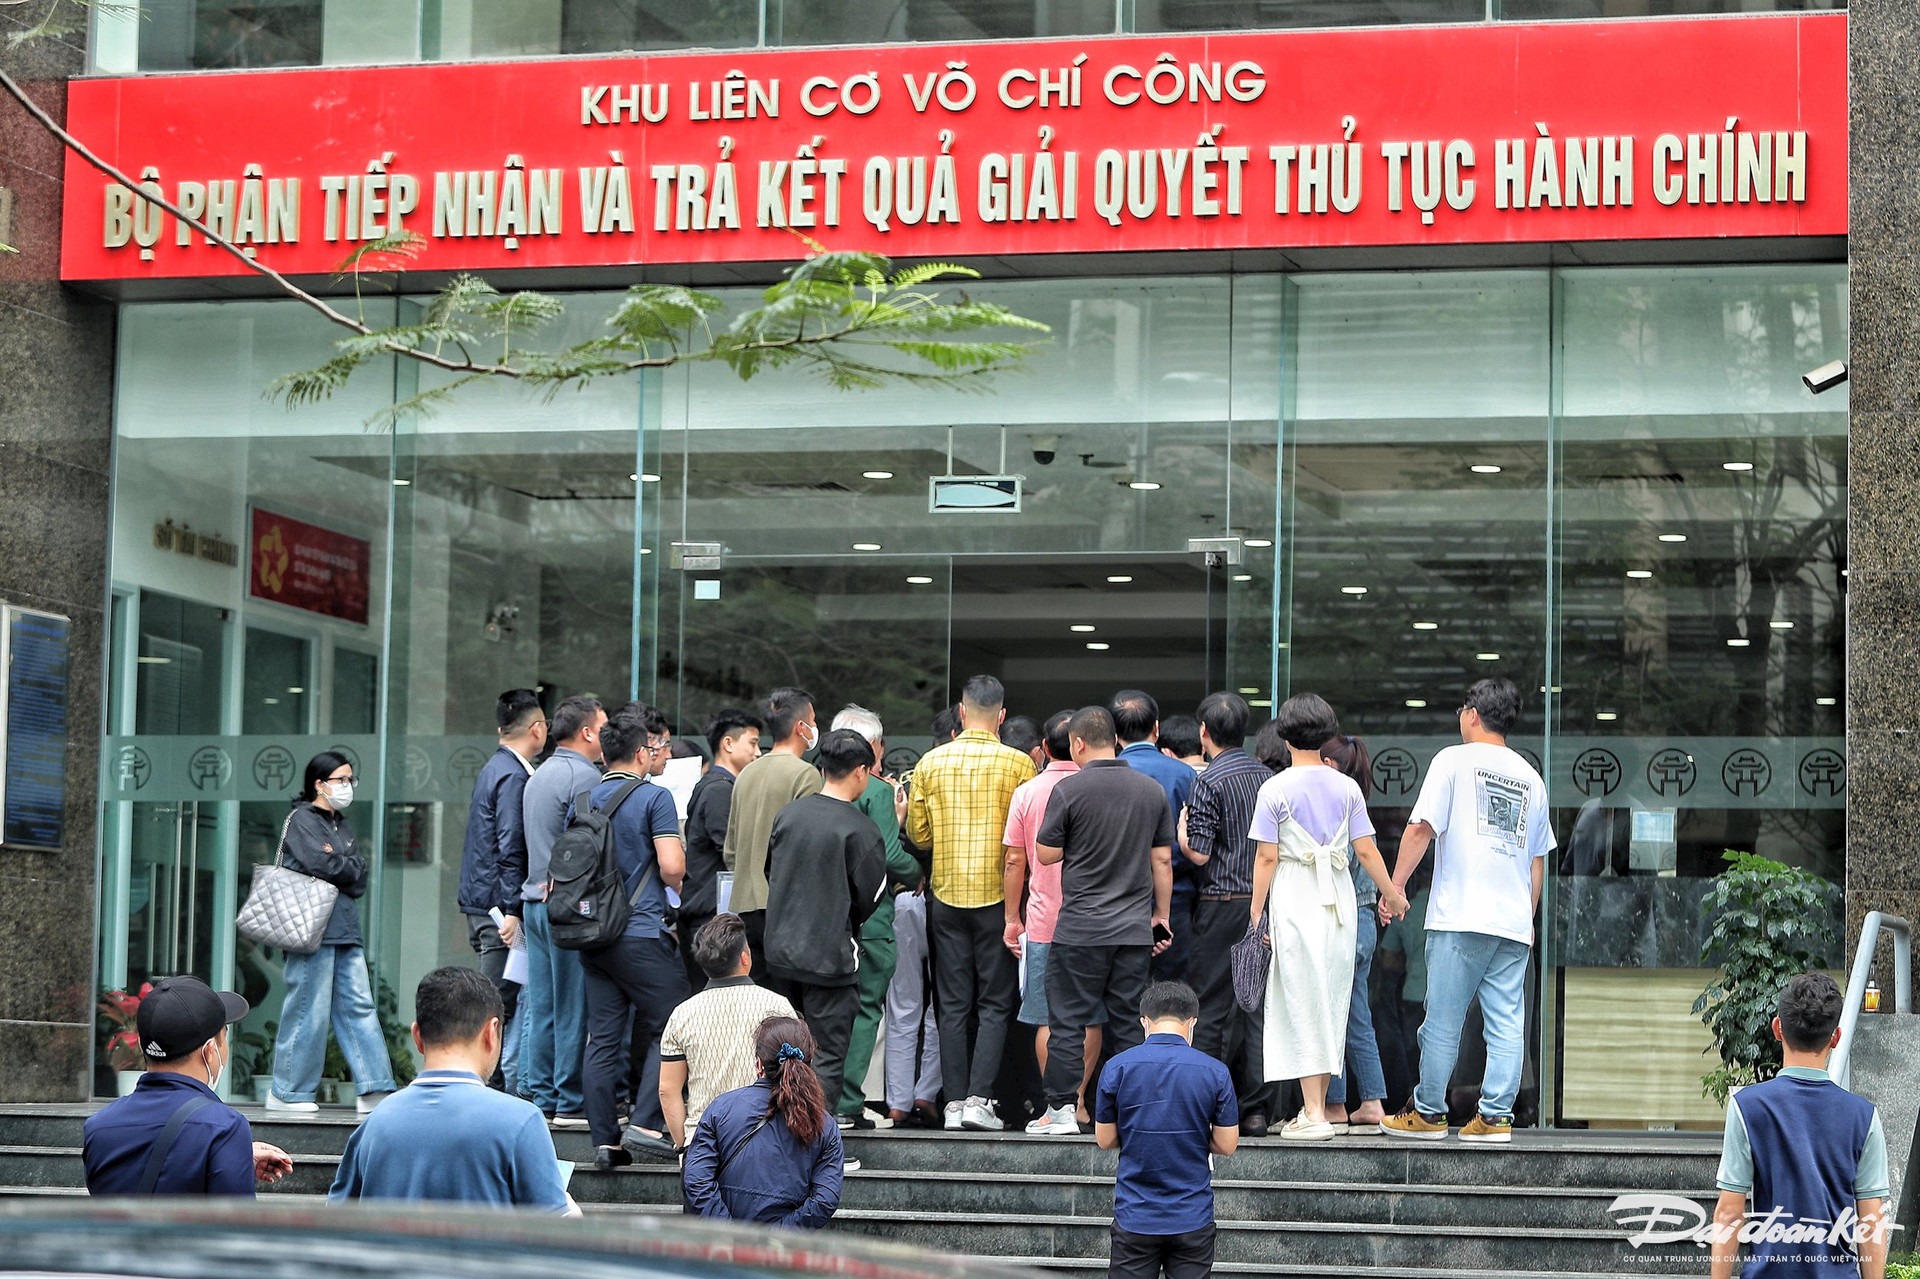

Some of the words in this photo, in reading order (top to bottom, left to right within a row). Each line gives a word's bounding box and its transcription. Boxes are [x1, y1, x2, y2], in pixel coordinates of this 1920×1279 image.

[580, 82, 669, 126] KHU
[689, 69, 780, 121] LIÊN
[800, 71, 882, 117] CƠ
[902, 61, 977, 112] VÕ
[998, 53, 1088, 110] CHÍ
[1103, 52, 1267, 106] CÔNG
[104, 166, 164, 262] BỘ
[176, 163, 300, 260] PHẬN
[320, 151, 420, 242] TIẾP
[433, 154, 563, 250] NHẬN
[578, 150, 635, 233] VÀ
[651, 135, 741, 232] TRẢ
[757, 135, 848, 228] KẾT
[862, 128, 961, 233] QUẢ
[978, 125, 1078, 224] GIẢI
[1094, 123, 1250, 227] QUYẾT
[1268, 114, 1363, 215] THỦ
[1380, 139, 1477, 225] TỤC
[1494, 121, 1635, 211] HÀNH
[1652, 115, 1808, 207] CHÍNH
[1477, 770, 1530, 792] UNCERTAIN
